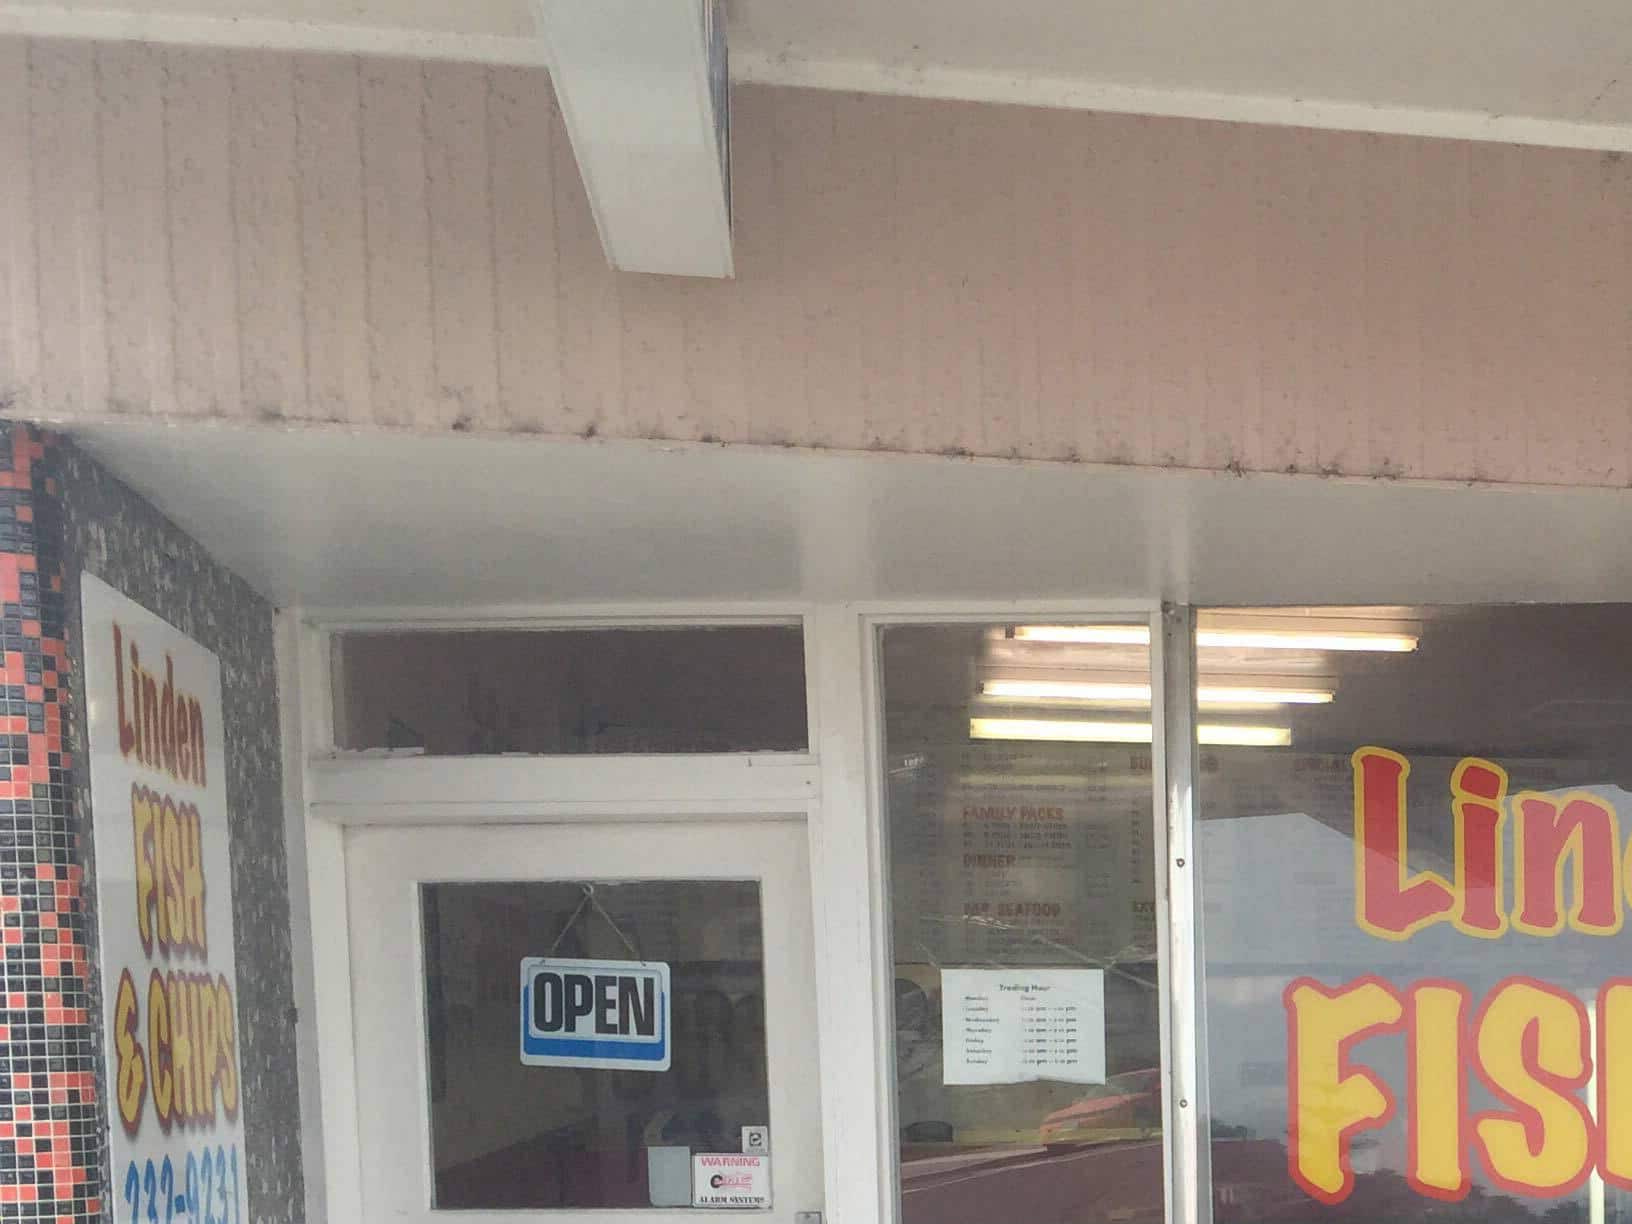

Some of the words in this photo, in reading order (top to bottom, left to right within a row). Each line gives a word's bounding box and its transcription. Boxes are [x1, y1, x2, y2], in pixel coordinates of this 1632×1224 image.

[112, 619, 206, 788] Linden
[131, 781, 208, 960] FISH
[114, 966, 147, 1138] &
[147, 966, 238, 1138] CHIPS
[533, 972, 655, 1037] OPEN
[701, 1157, 761, 1167] WARNING
